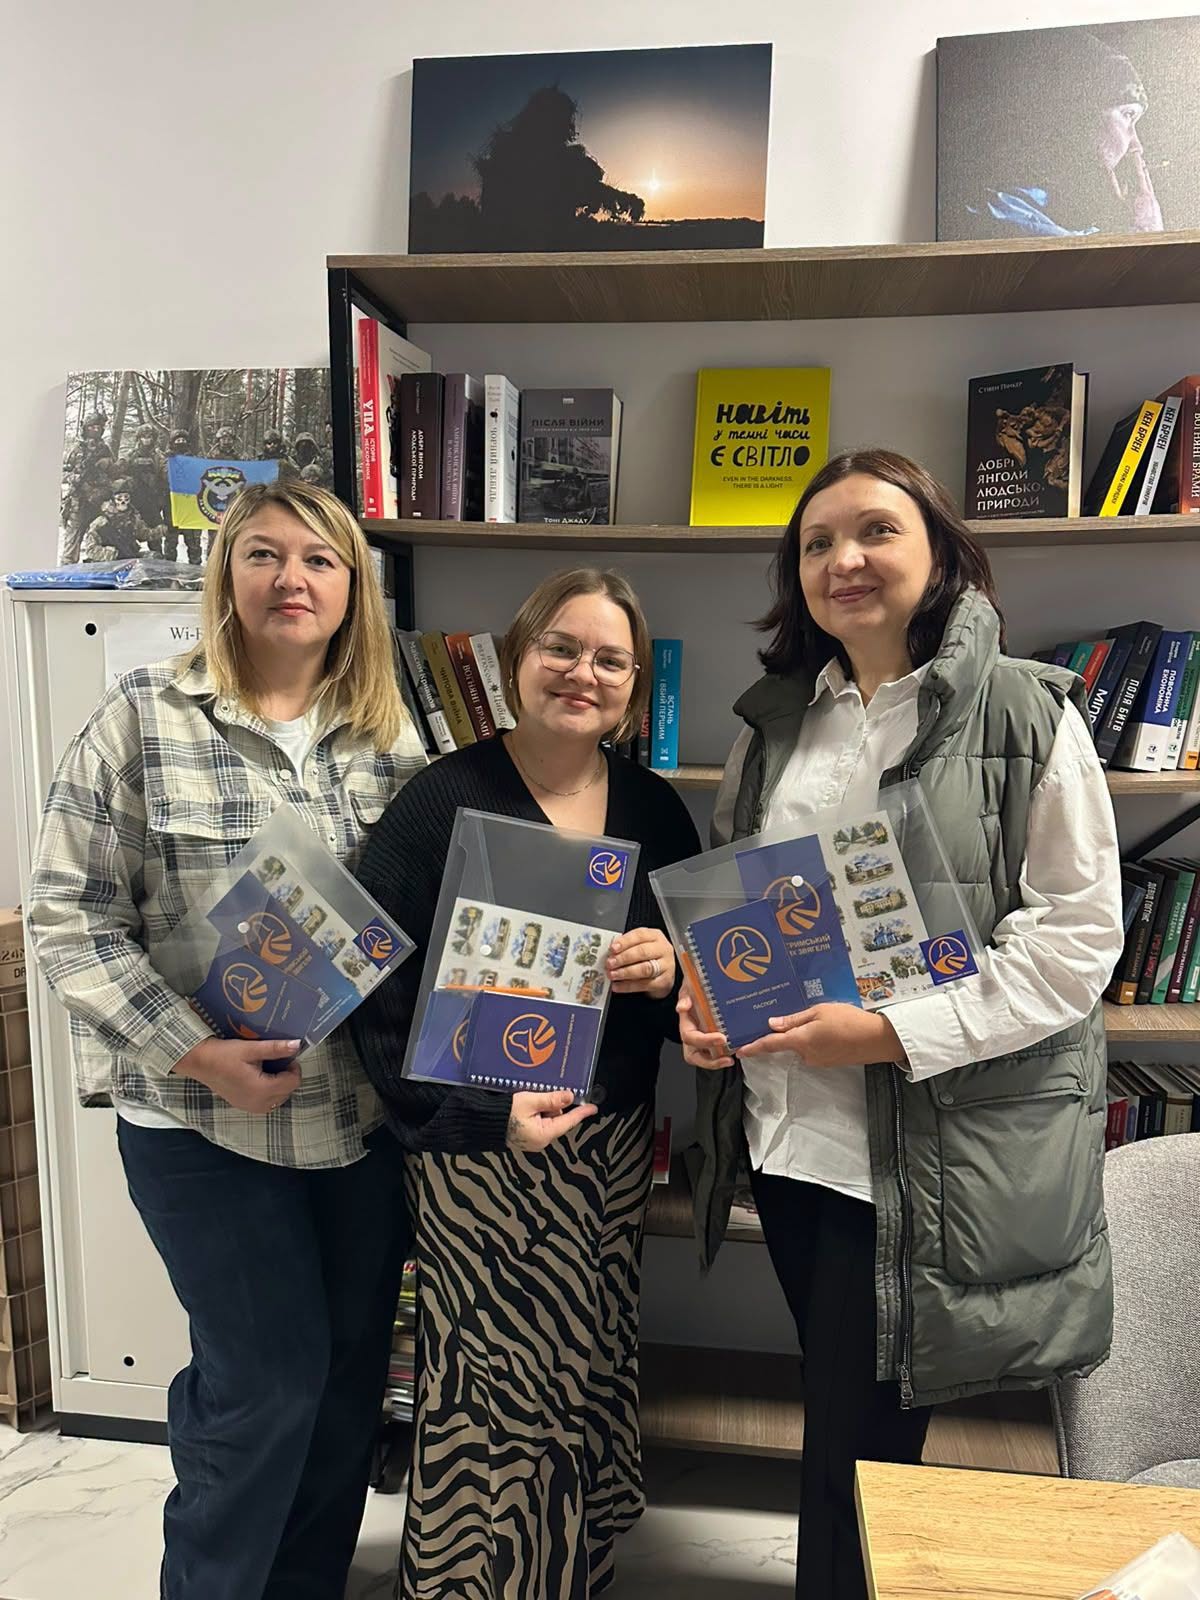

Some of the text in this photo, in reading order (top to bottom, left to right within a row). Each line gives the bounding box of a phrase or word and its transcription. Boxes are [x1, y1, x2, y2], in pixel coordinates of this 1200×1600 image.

[364, 399, 374, 436] УПА
[569, 418, 605, 426] ВІЙНИ
[1131, 411, 1154, 452] КЕН БРУЕН
[1156, 407, 1176, 450] КЕН БРУЕН
[729, 429, 768, 439] темні
[776, 431, 810, 440] часи
[489, 427, 498, 503] ЧОРНИЙ ЛЕБІДЬ
[711, 446, 810, 467] Є СВІТЛО
[977, 458, 1014, 472] ДОБРІ
[976, 482, 1045, 498] ЛЮДСЬКО
[977, 470, 1028, 484] ЯНГОЛИ
[1192, 462, 1200, 497] БРАМИ
[977, 496, 1039, 511] ПРИРОДИ
[408, 641, 424, 672] Максим
[440, 667, 453, 699] ЧИПОВА
[659, 683, 667, 704] ВБИЙ
[1123, 679, 1139, 705] ПОЛЯ
[1154, 669, 1169, 714] ЕКОНОМІКА
[1162, 670, 1176, 713] ПОВОЄННА
[462, 664, 490, 737] ВОГНЯНІ БРАМИ
[658, 705, 666, 740] ПЕРШИМ
[1112, 707, 1129, 732] БИТВ
[1168, 902, 1180, 941] РОЗВІДНИКА
[1176, 939, 1190, 983] КОНСЕРВАТОРОМ
[752, 998, 777, 1009] ПАСПОРТ
